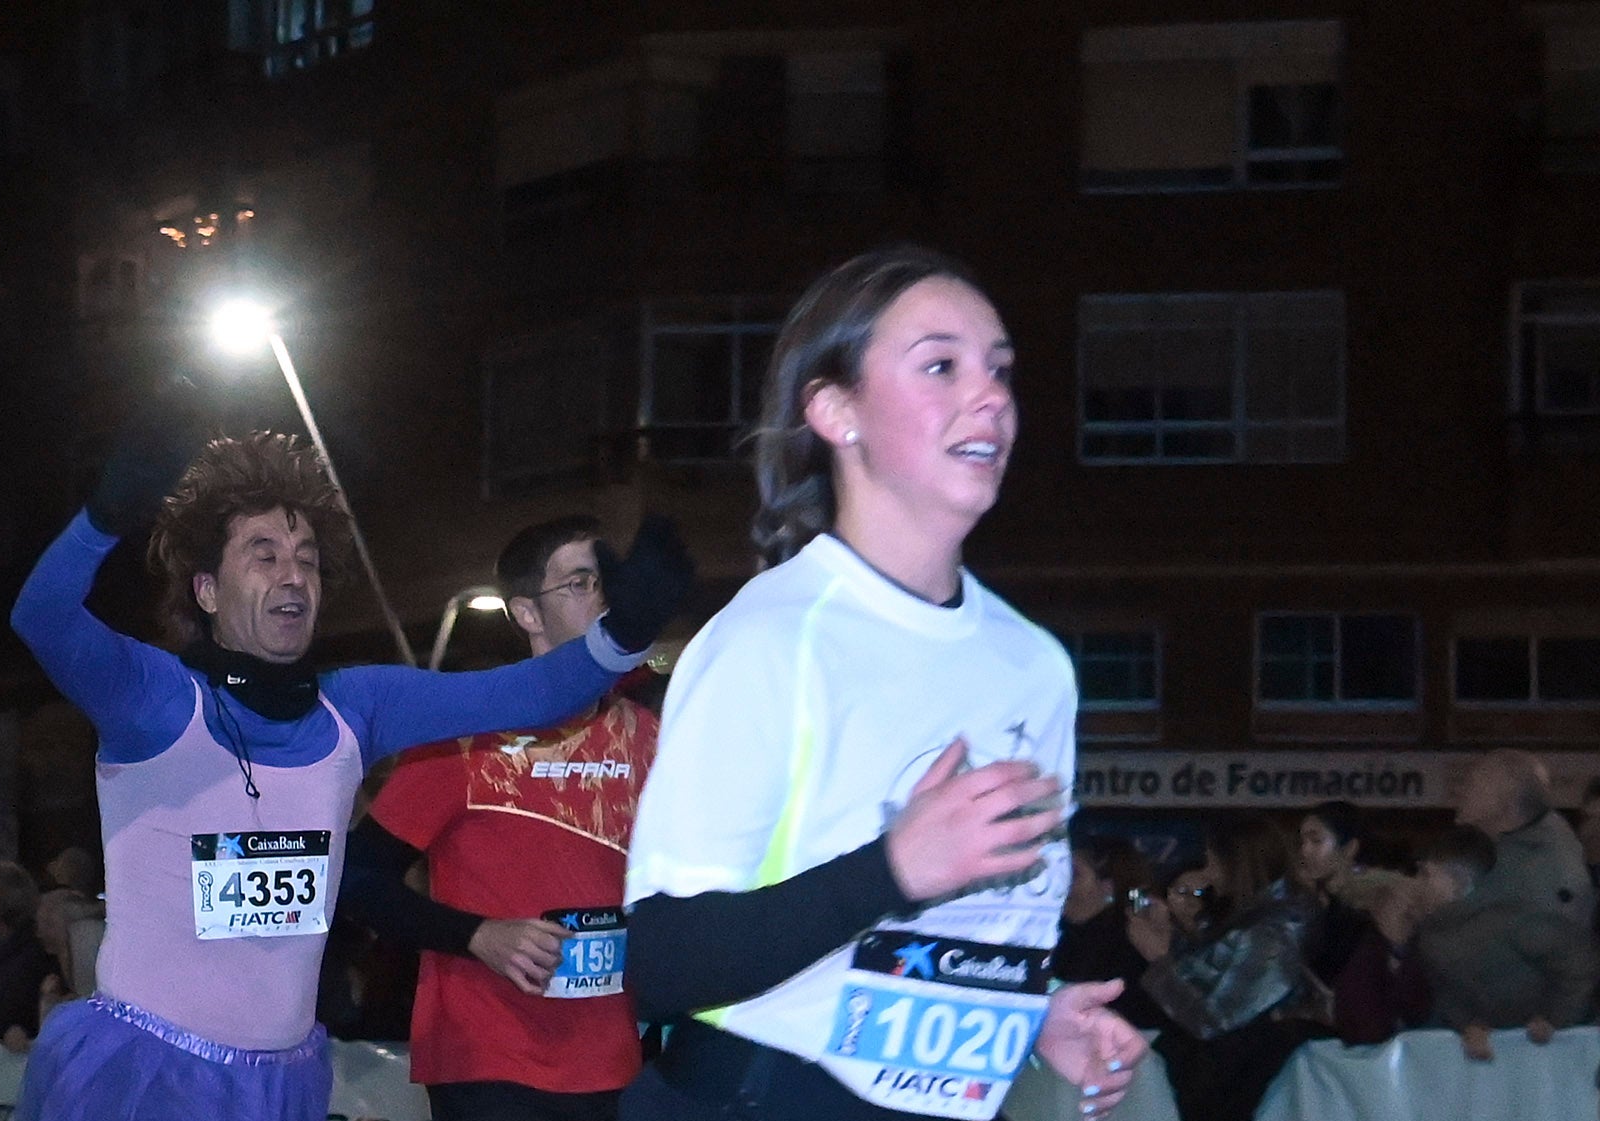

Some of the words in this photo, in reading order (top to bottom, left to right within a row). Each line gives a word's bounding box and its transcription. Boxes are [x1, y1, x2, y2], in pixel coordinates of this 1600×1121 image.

[531, 759, 631, 779] ESPAÑA
[1172, 759, 1216, 797] de
[1227, 759, 1424, 797] Formación
[248, 836, 306, 851] CaixaBank
[219, 868, 316, 908] 4353
[229, 911, 286, 927] FIATC
[569, 939, 615, 973] 159
[877, 997, 1030, 1075] 1020
